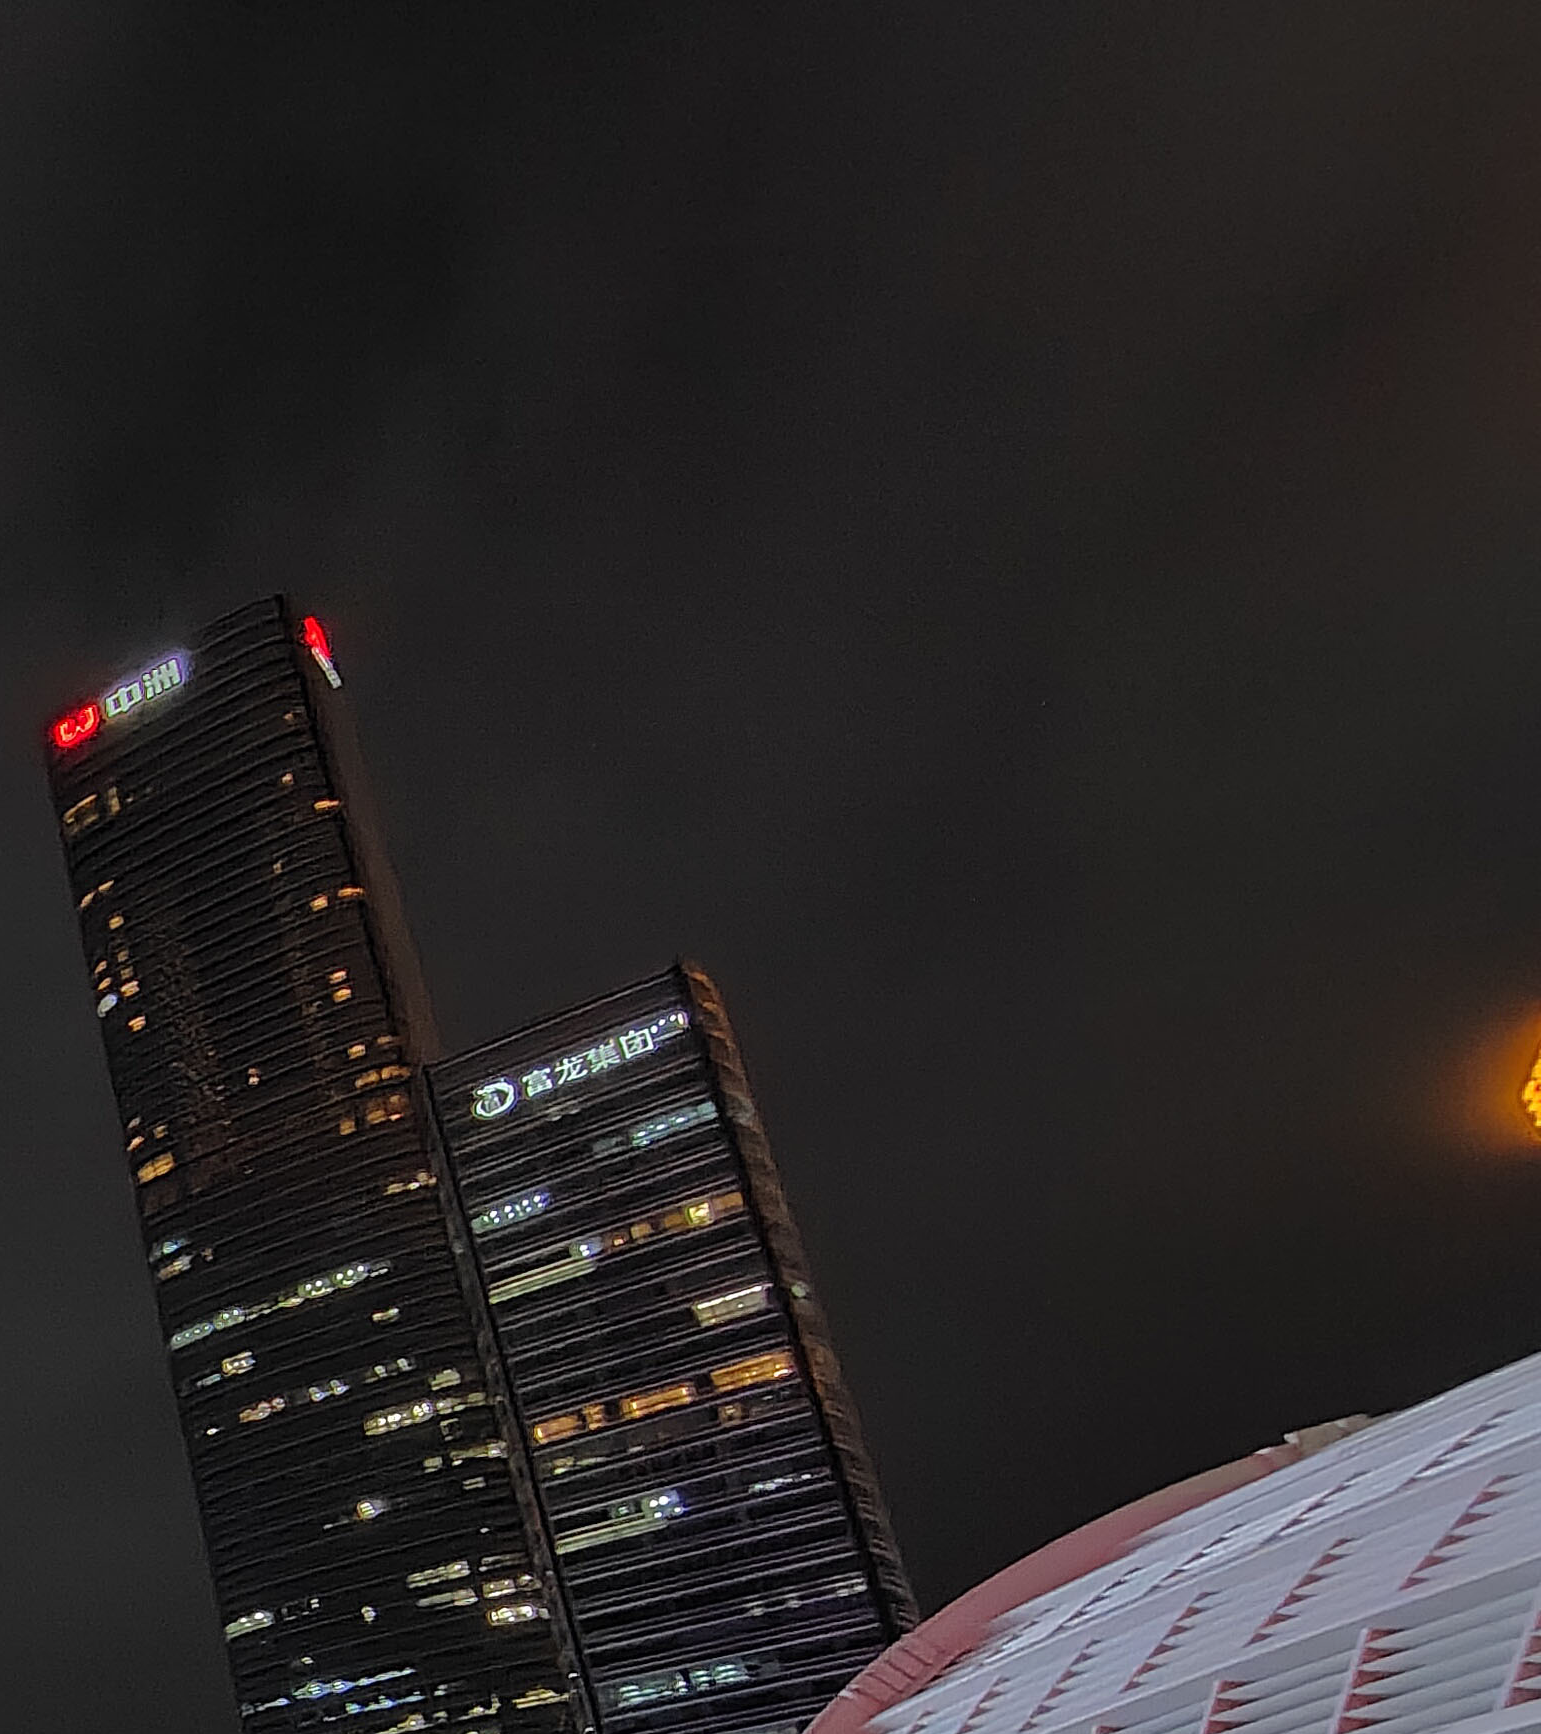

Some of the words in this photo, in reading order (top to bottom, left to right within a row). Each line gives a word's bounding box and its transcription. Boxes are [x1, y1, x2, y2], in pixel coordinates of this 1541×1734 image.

[105, 658, 185, 718] 中洲
[521, 1027, 656, 1098] 富龙集团
